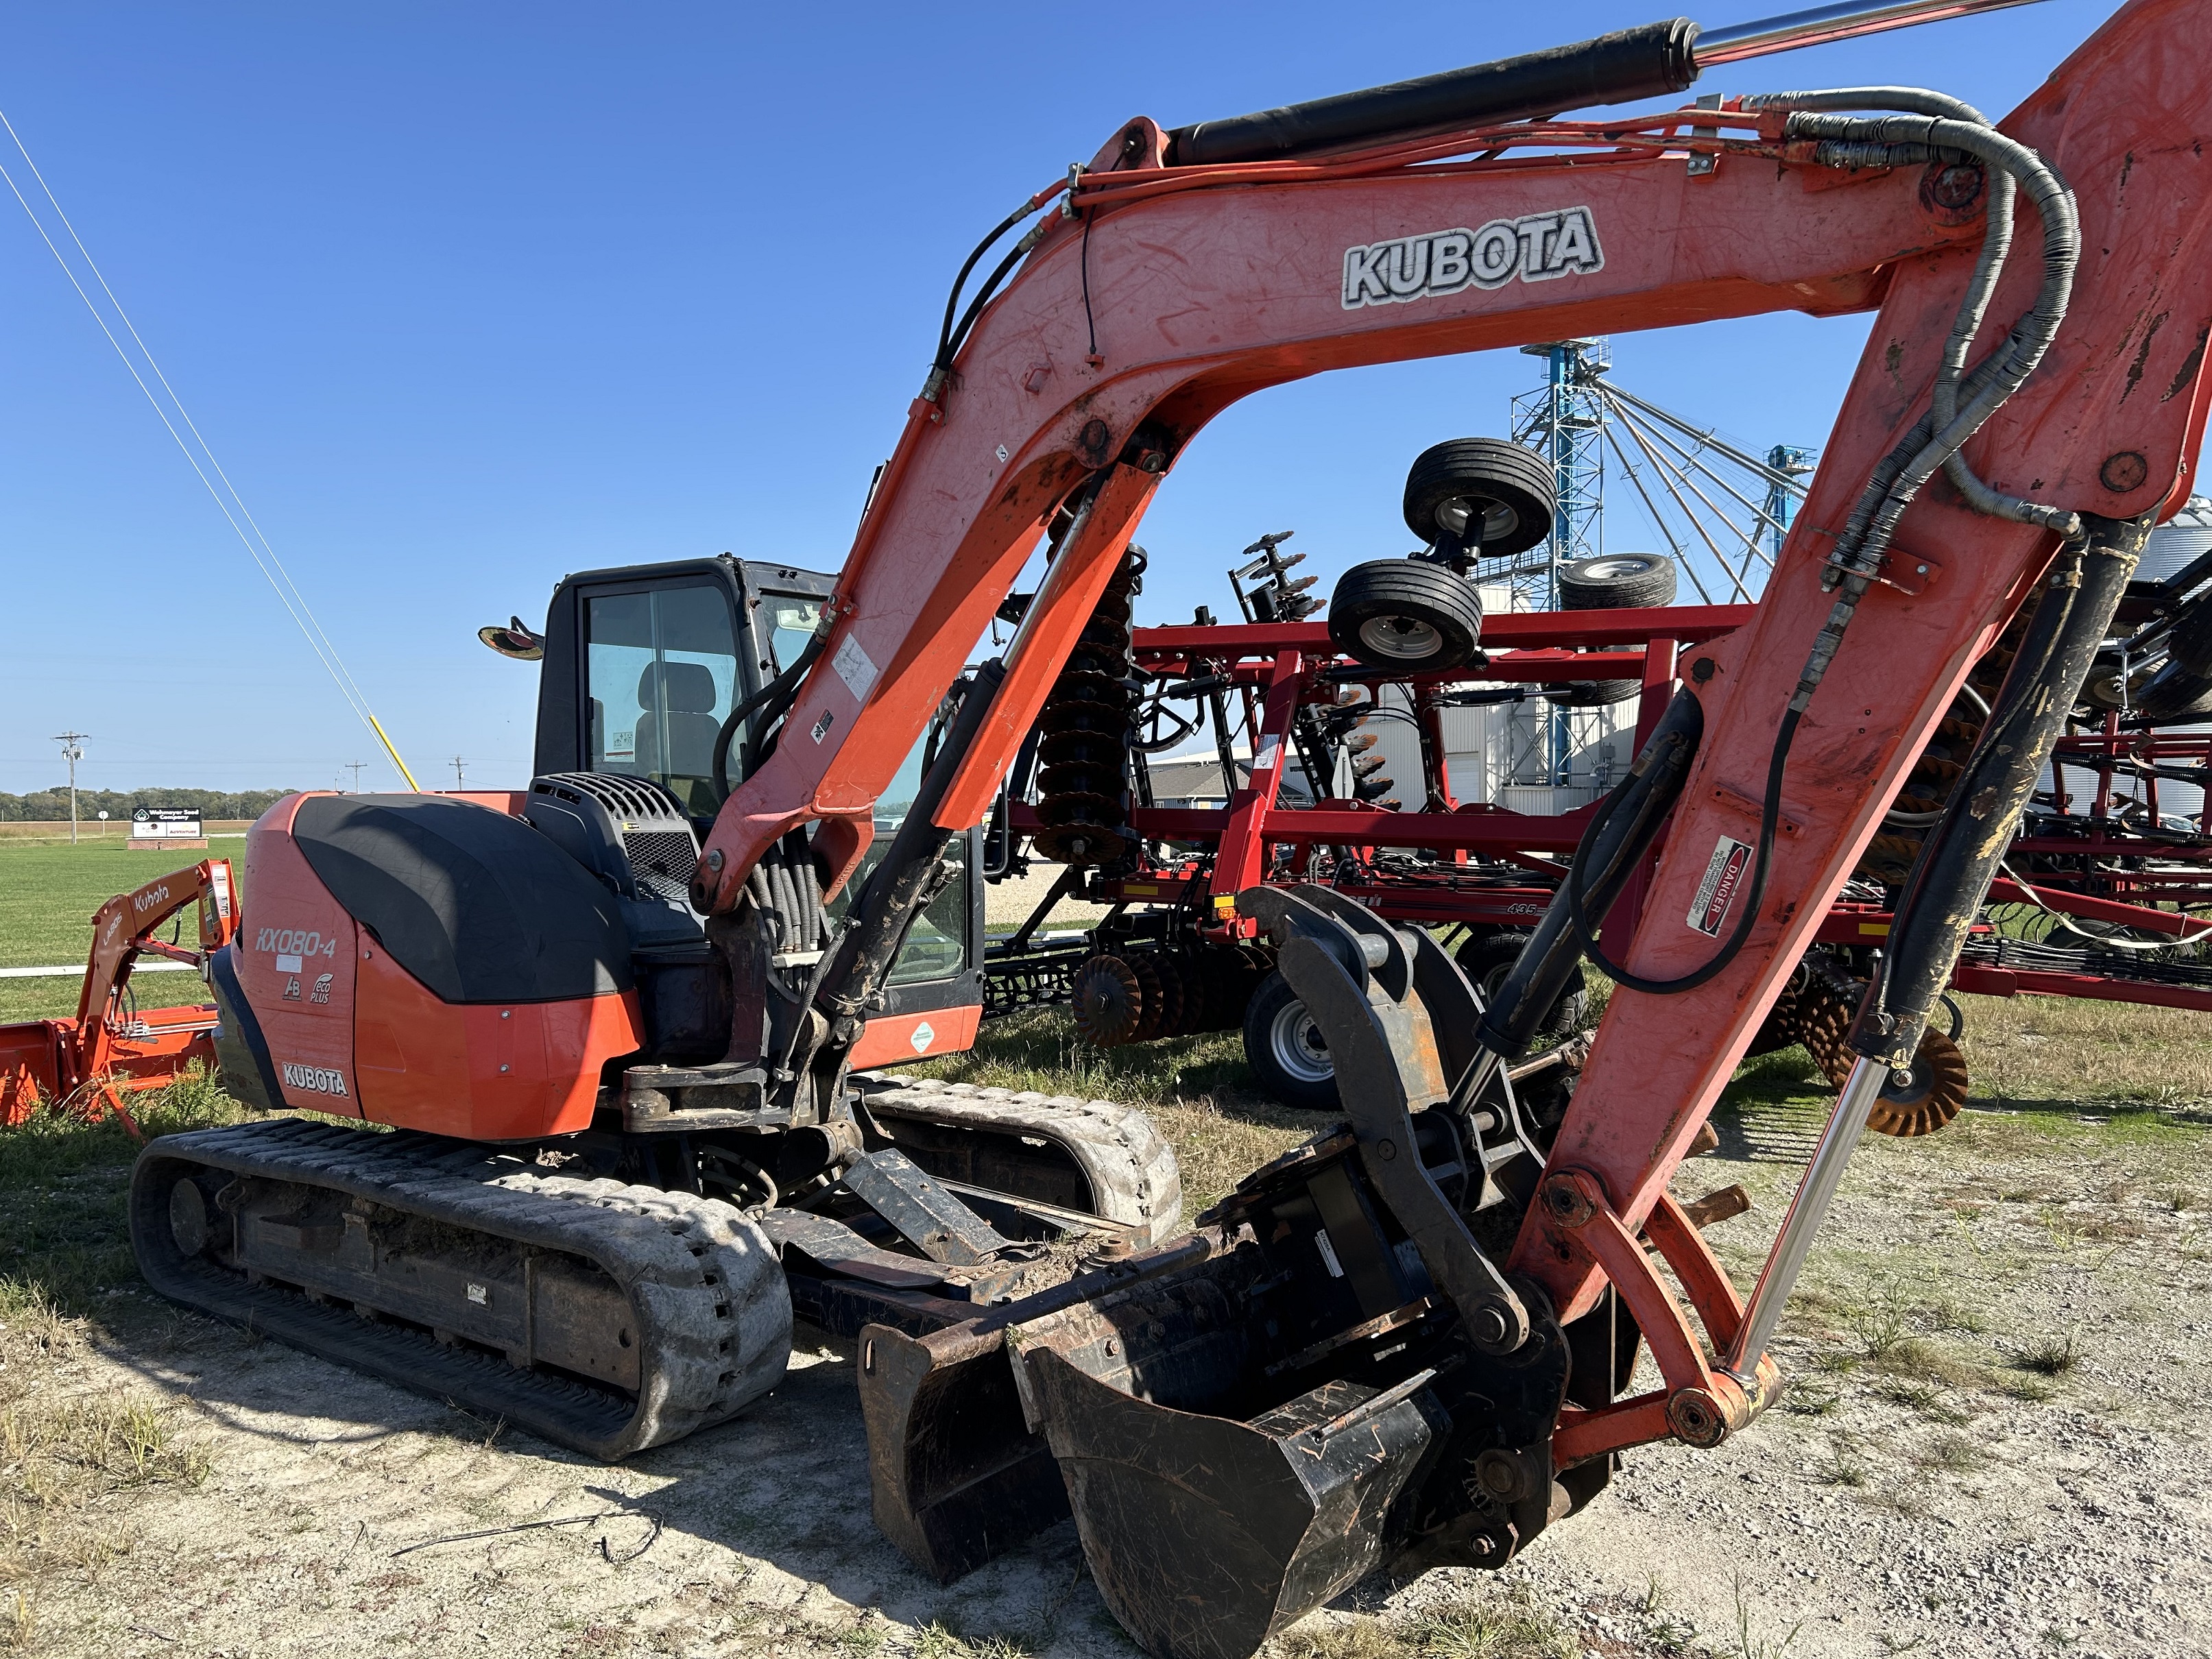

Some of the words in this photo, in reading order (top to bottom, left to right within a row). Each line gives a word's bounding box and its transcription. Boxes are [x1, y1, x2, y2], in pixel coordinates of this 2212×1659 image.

[1345, 210, 1600, 304] KUBOTA
[135, 884, 169, 912] Kubota
[1711, 864, 1738, 914] DANGER
[1507, 903, 1537, 915] 435
[104, 912, 123, 946] LA805
[255, 928, 337, 958] KX080-4
[311, 992, 330, 1004] PLUS
[315, 982, 330, 993] eco
[282, 1063, 348, 1096] KUBOTA
